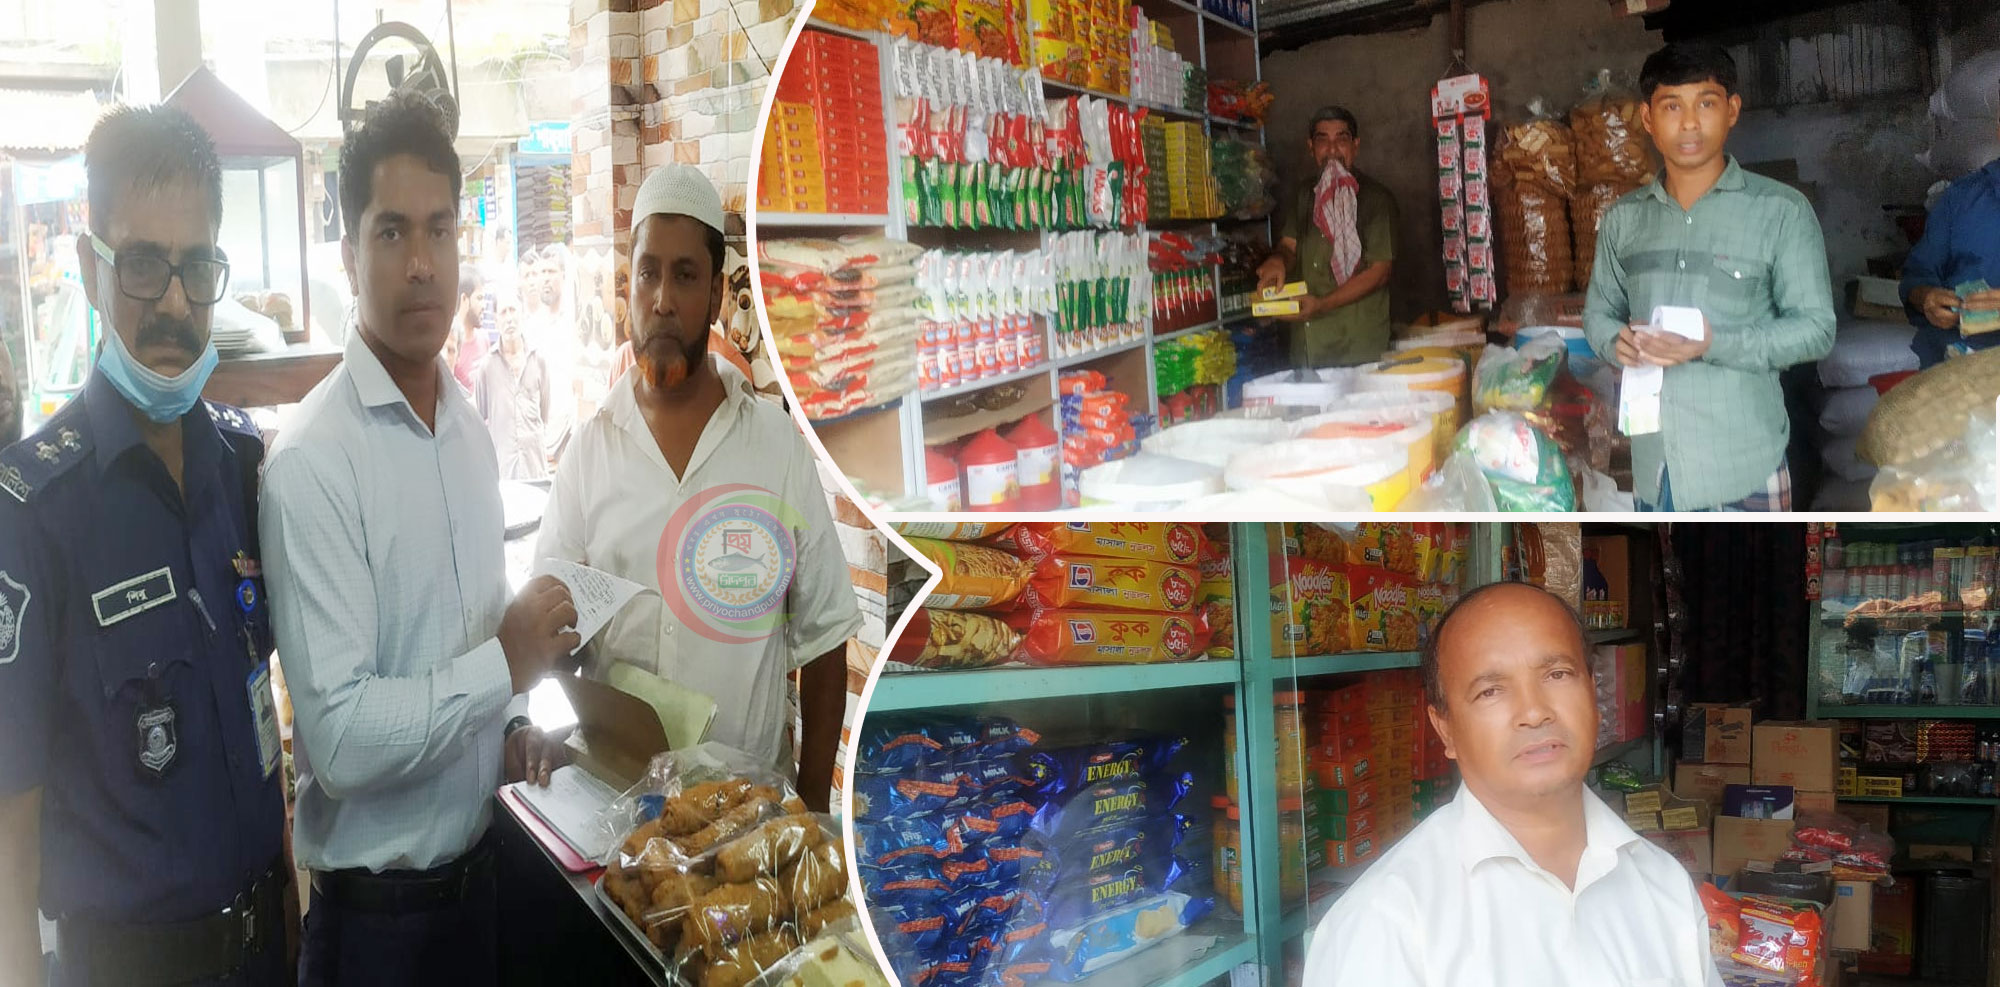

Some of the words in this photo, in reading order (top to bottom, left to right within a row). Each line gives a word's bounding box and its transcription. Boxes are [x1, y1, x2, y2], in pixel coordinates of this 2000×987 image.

[1293, 566, 1334, 601] Noodles
[1373, 582, 1407, 612] Noodles
[989, 726, 1010, 738] MILK
[983, 767, 1008, 779] MILK
[1087, 760, 1131, 782] ENERGY
[1094, 792, 1139, 815] ENERGY
[1091, 876, 1137, 903] ENERGY
